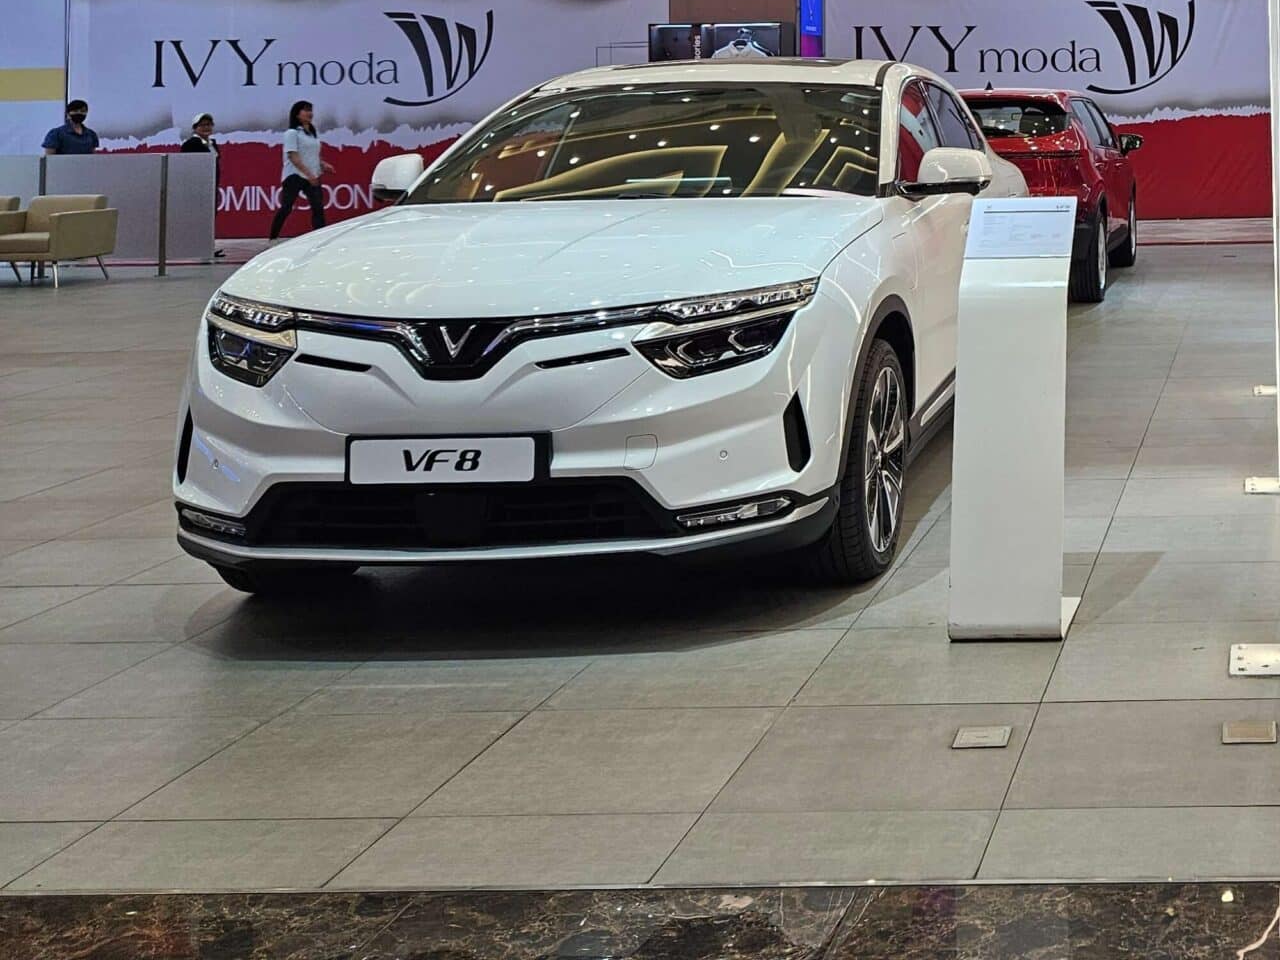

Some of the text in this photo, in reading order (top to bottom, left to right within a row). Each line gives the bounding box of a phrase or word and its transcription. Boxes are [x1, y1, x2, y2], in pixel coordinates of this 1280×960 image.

[151, 38, 277, 88] IVY
[277, 52, 400, 86] moda
[853, 25, 977, 73] IVY
[979, 40, 1103, 73] moda
